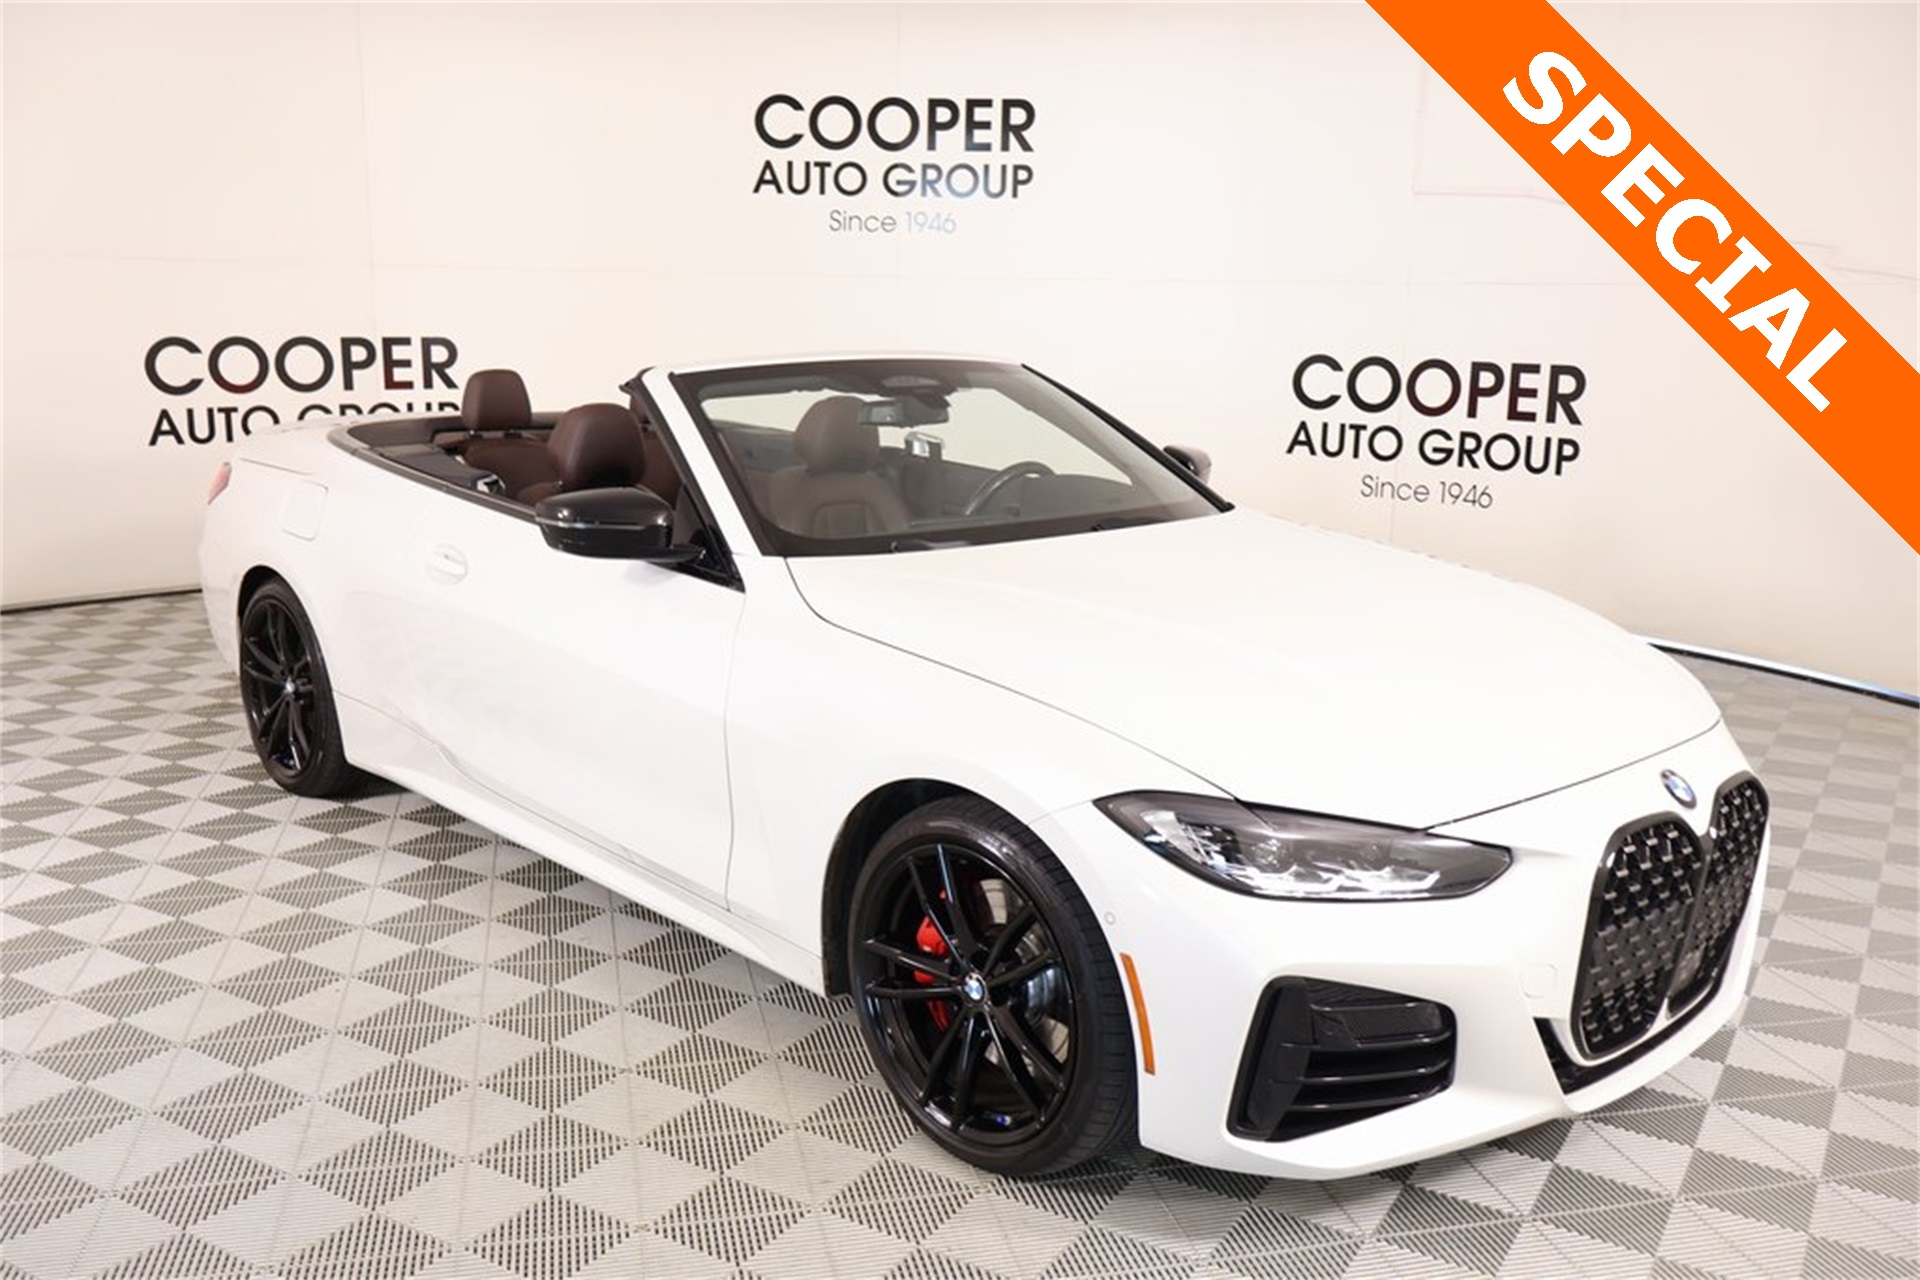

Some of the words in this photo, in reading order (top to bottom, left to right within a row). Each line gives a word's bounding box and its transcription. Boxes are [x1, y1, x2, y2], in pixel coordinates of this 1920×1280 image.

[753, 93, 1036, 153] COOPER
[752, 159, 869, 198] AUTO
[881, 162, 1034, 200] GROUP
[828, 209, 897, 233] Since
[905, 211, 957, 234] 1946
[144, 336, 459, 396] COOPER
[1291, 353, 1587, 426] COOPER
[1285, 420, 1404, 463] AUTO
[1417, 428, 1581, 477] GROUP
[1360, 474, 1430, 503] Since
[1439, 480, 1494, 510] 1946
